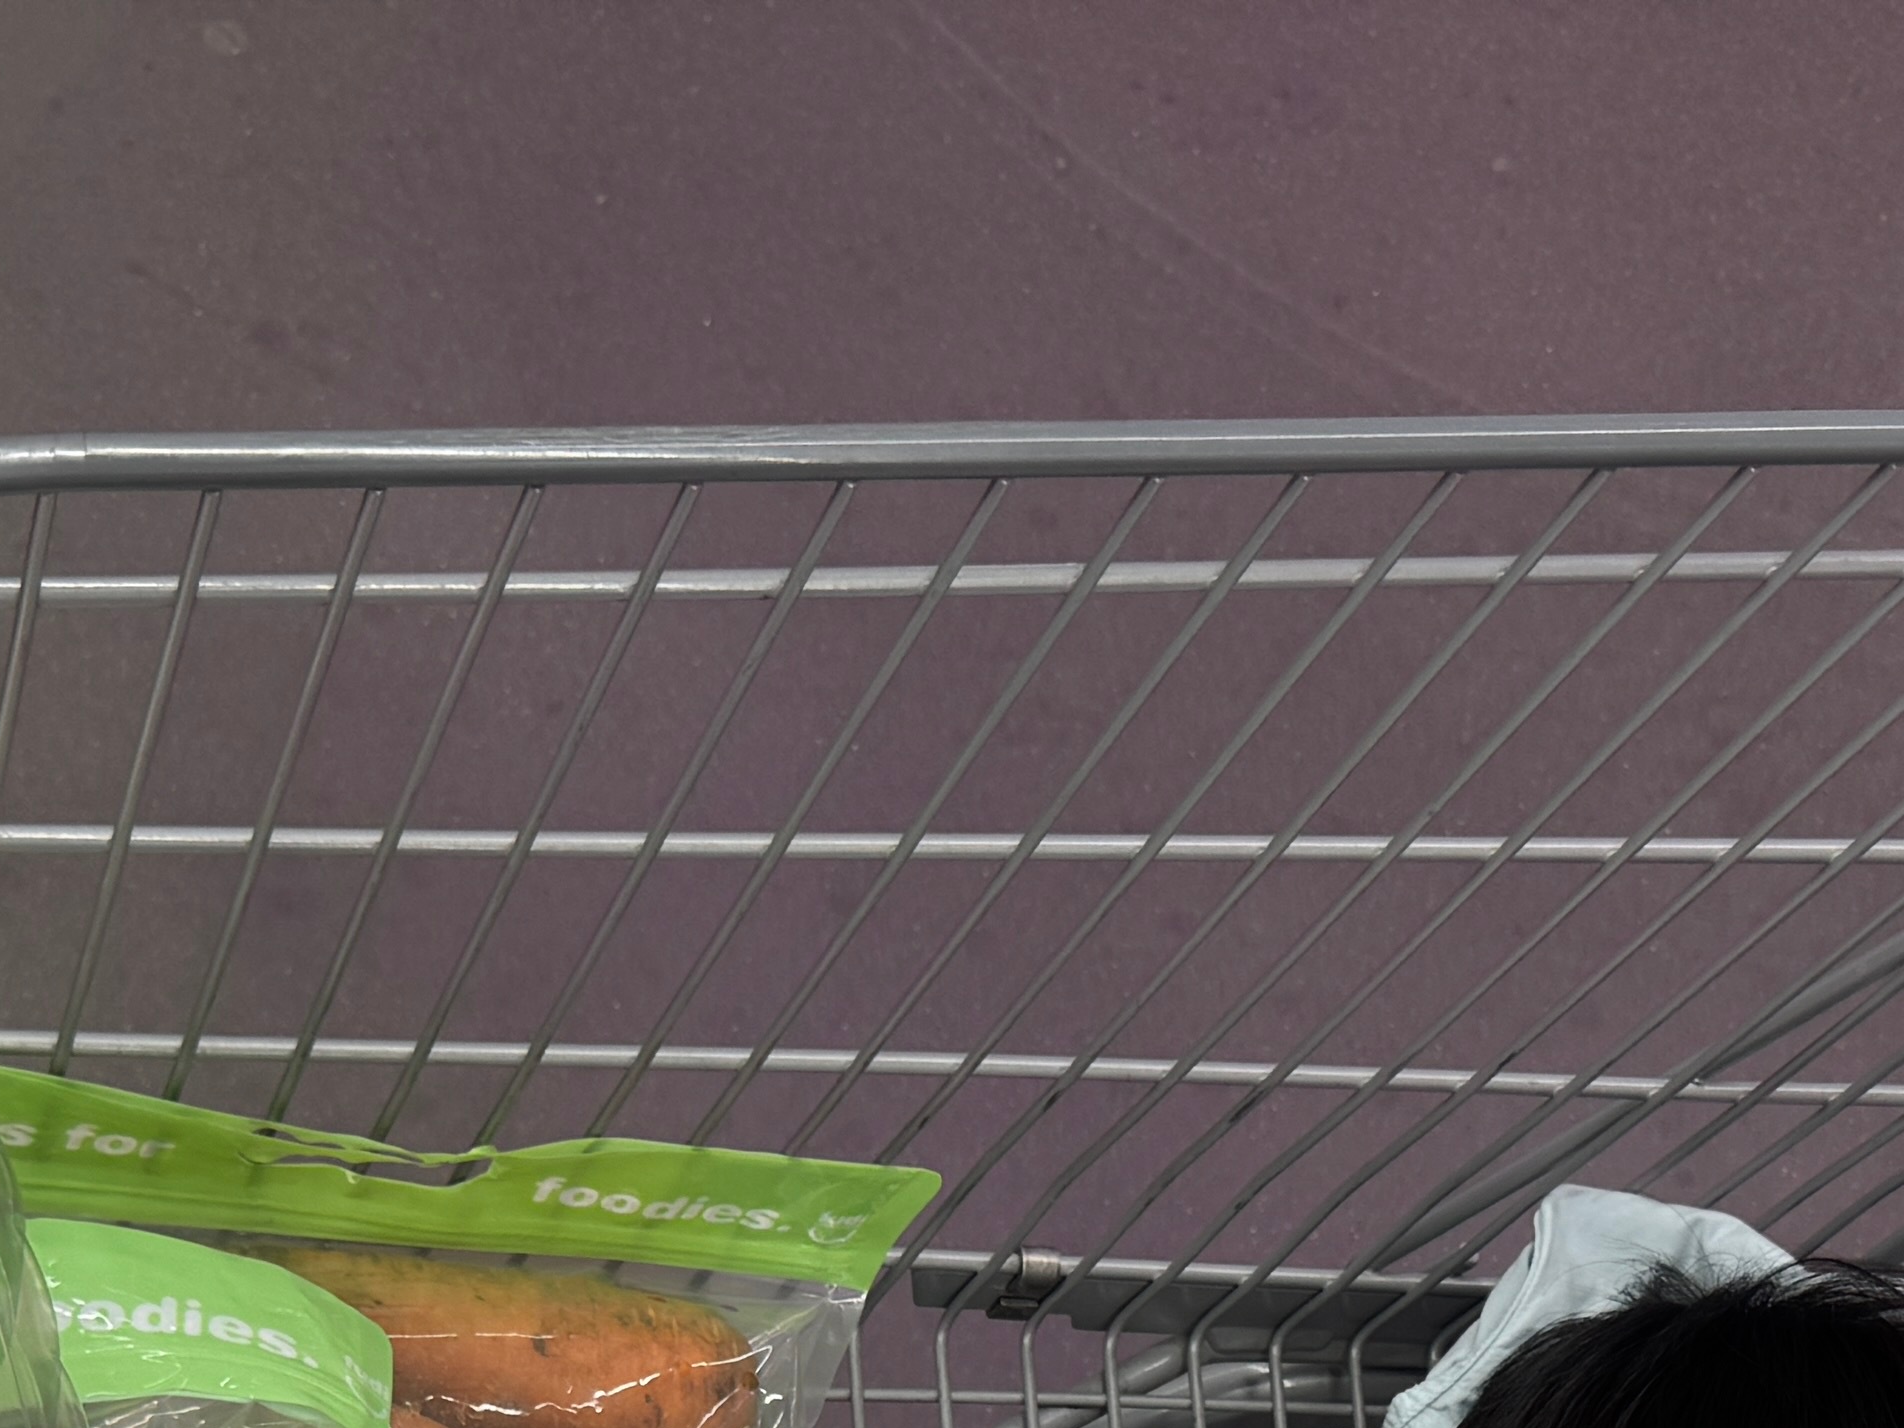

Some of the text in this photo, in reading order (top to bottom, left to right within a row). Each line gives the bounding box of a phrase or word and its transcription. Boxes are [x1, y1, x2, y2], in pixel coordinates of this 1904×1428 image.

[65, 1123, 175, 1159] for
[532, 1176, 791, 1233] foodies.
[53, 1296, 319, 1369] odies.
